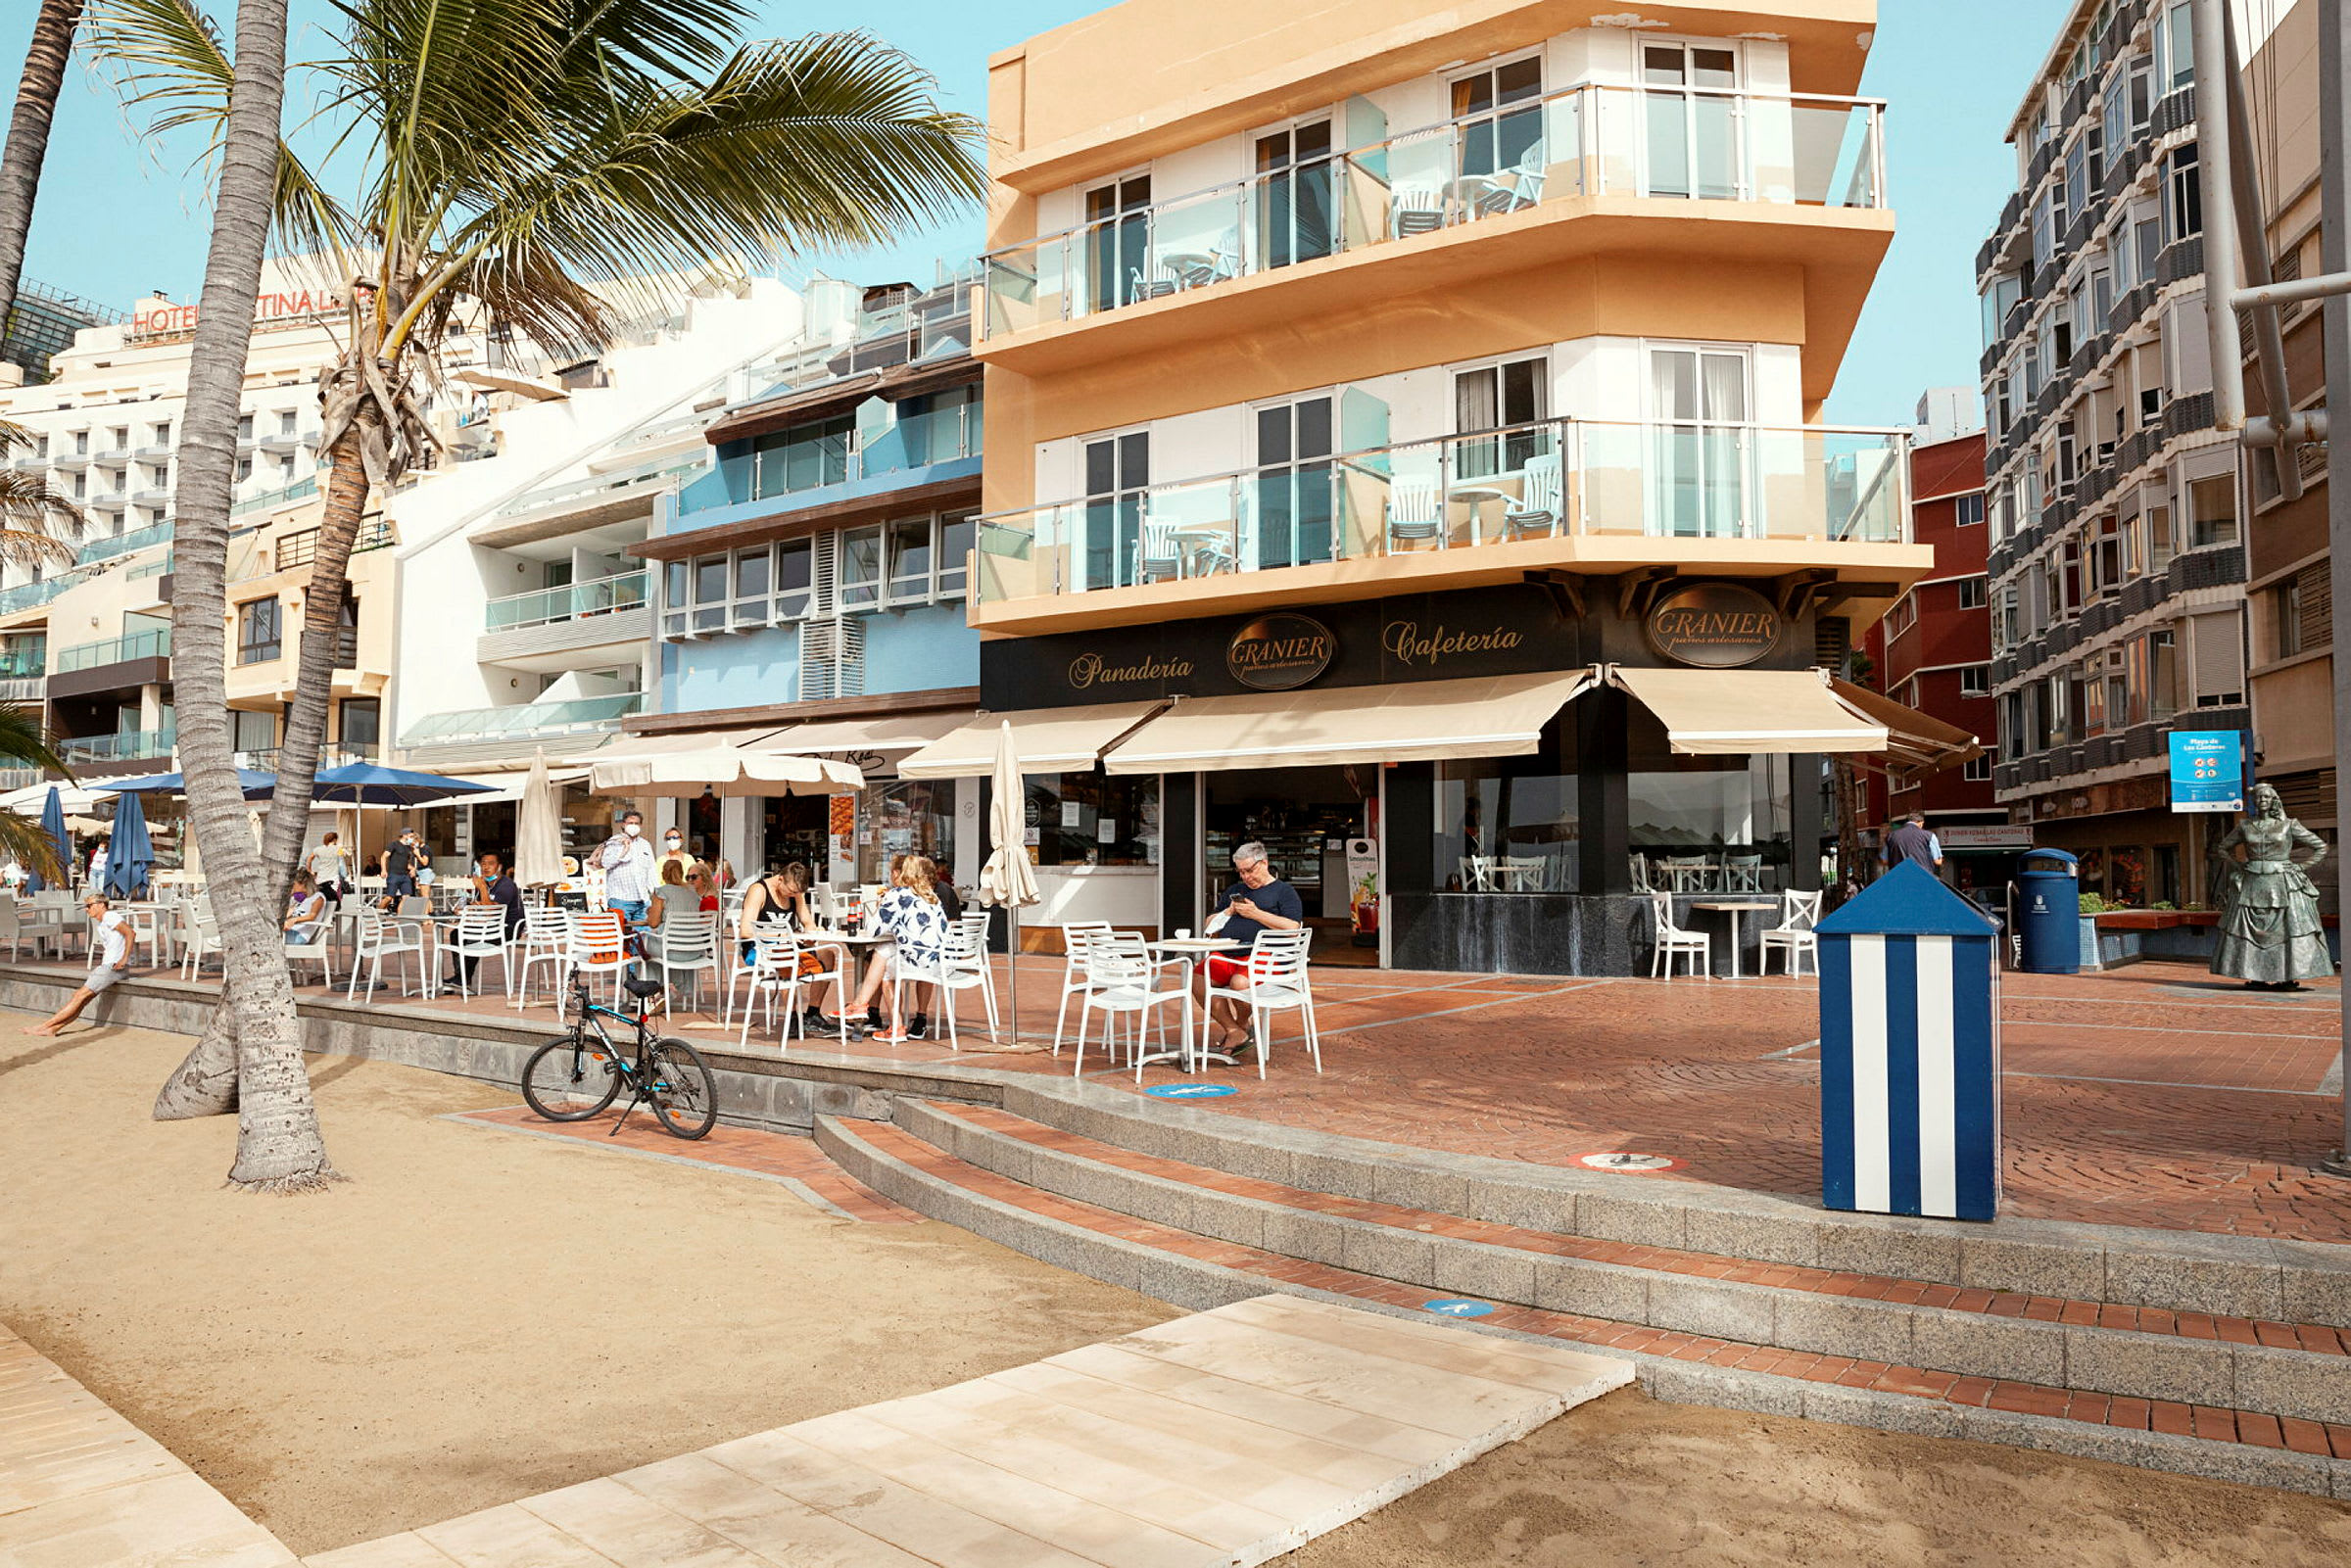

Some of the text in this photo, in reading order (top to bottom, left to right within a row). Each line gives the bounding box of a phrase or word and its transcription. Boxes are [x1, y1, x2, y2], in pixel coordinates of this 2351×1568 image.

[1655, 611, 1773, 639] GRANIER
[1231, 636, 1326, 666] GRANIER
[1382, 620, 1524, 665] Cafetería
[1069, 652, 1194, 689] Panadería
